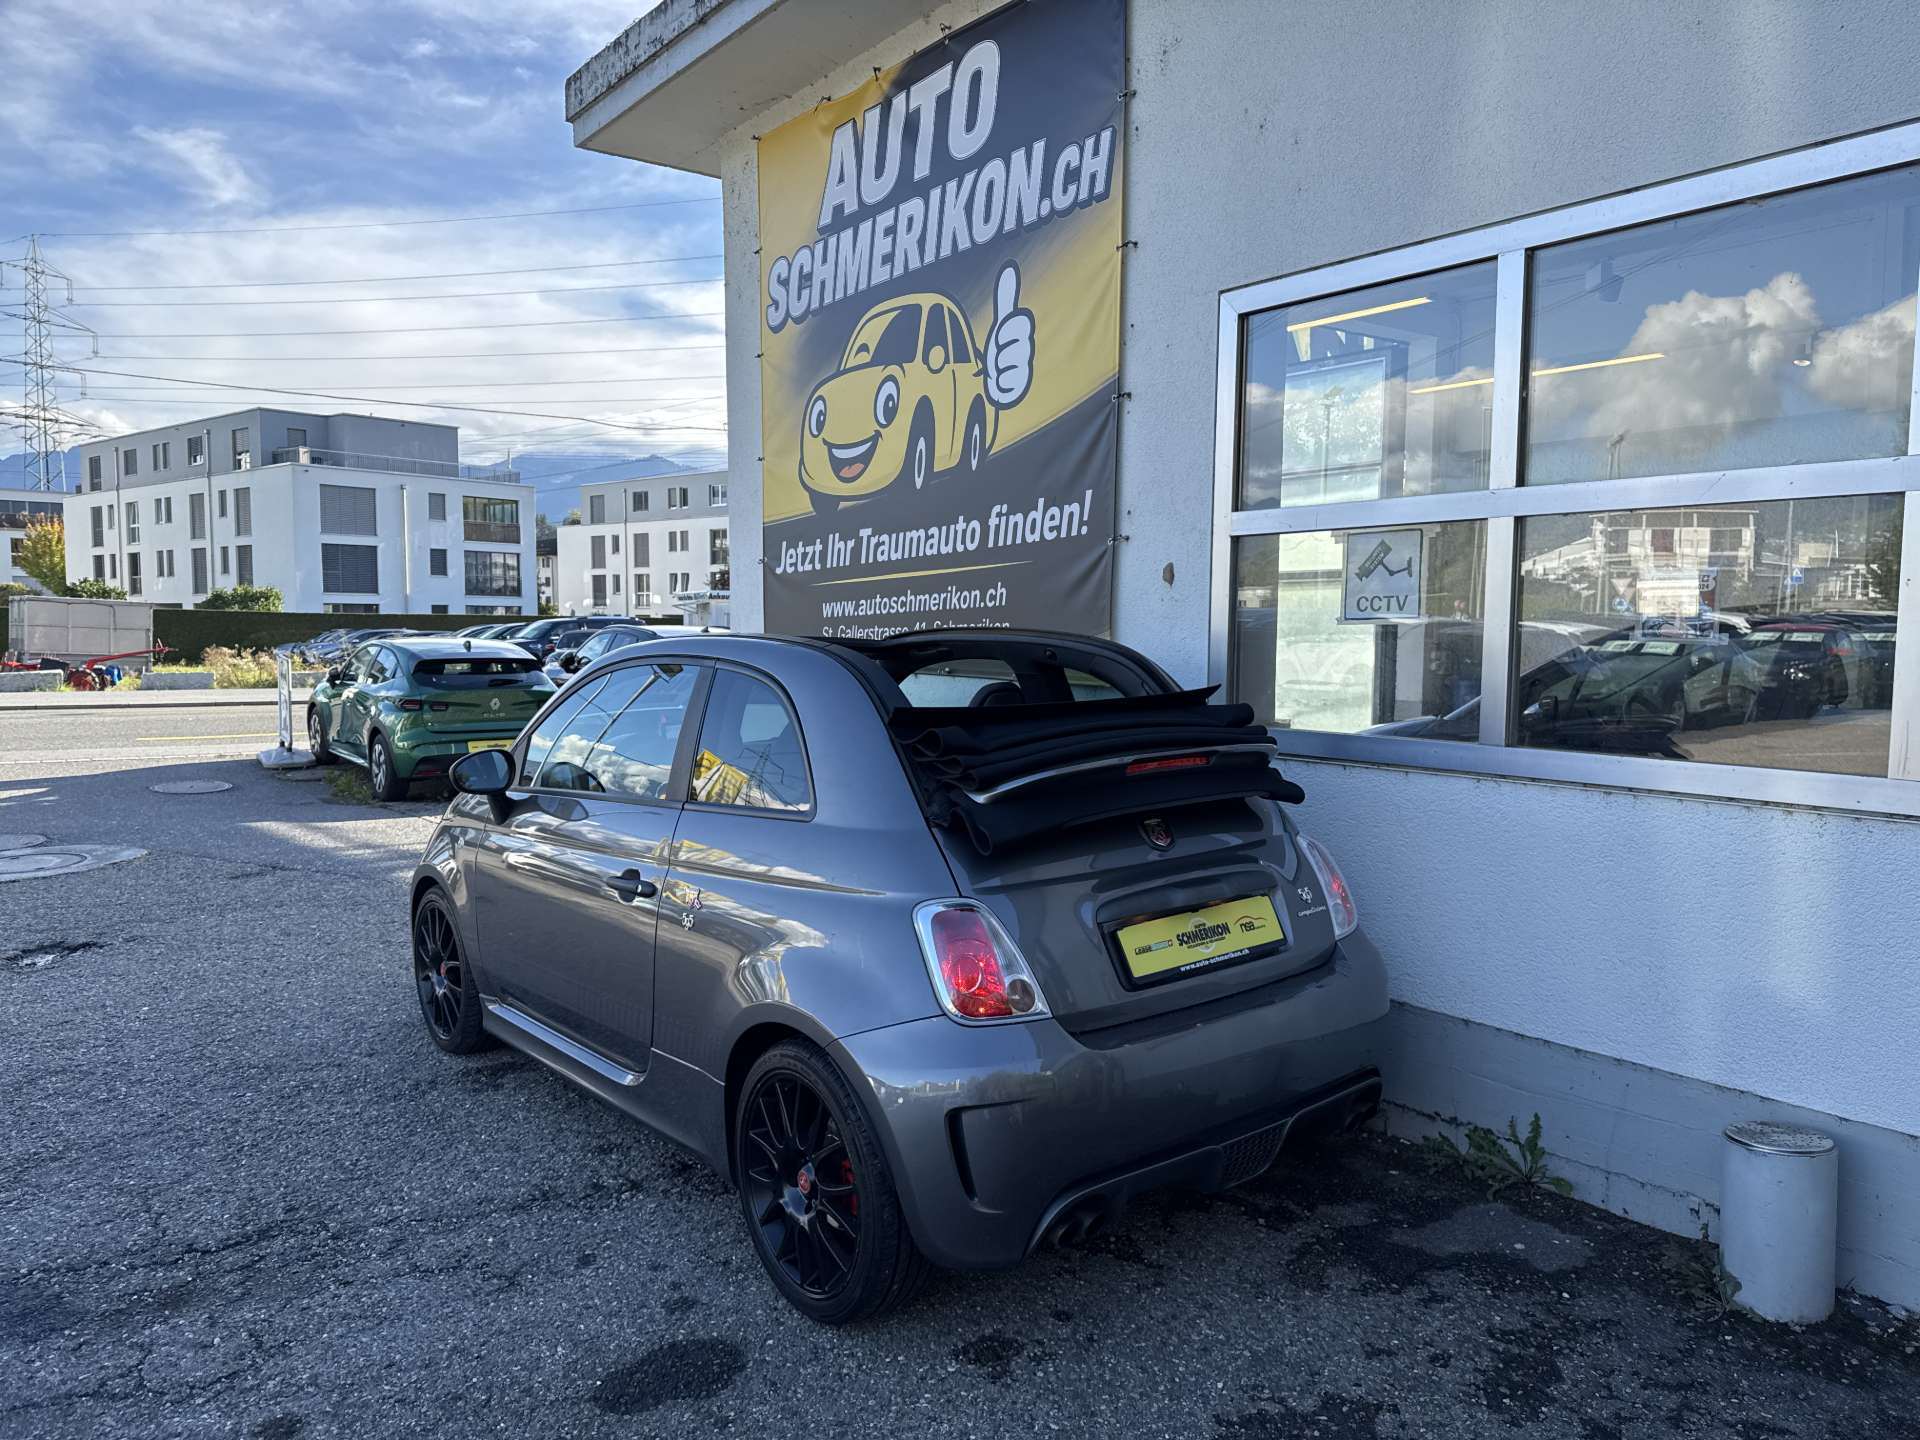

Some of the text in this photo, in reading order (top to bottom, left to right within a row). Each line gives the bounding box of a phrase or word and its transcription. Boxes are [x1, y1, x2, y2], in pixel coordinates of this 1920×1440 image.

[817, 39, 1000, 230] AUTO
[766, 127, 1114, 330] SCHMERIKON.CH
[775, 489, 1093, 575] Jetzt Ihr Traumauto finden!
[822, 582, 1007, 618] www.autoschmerikon.ch
[1356, 595, 1409, 612] CCTV
[1176, 921, 1231, 947] SCHMERIKON
